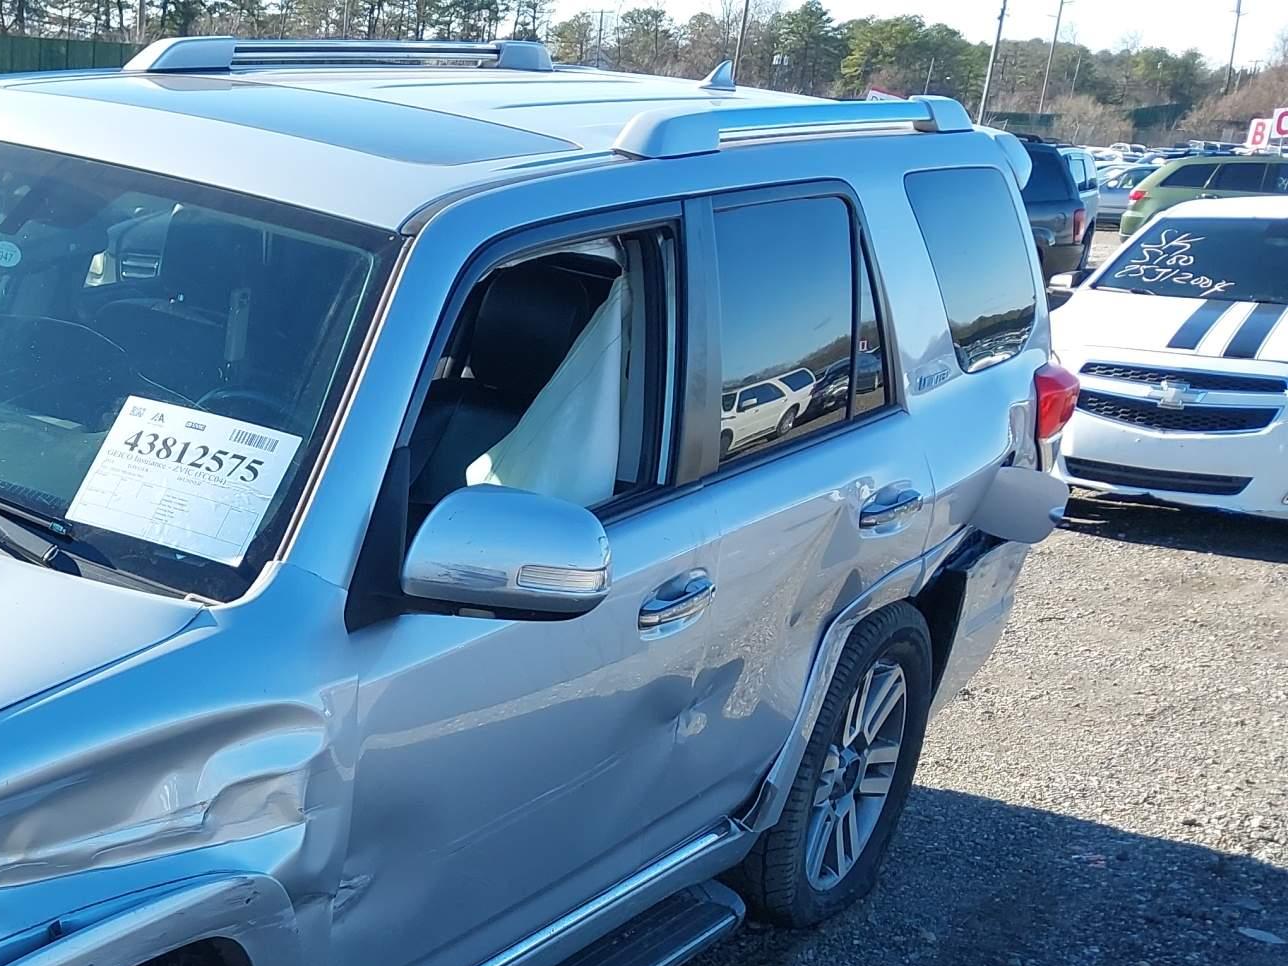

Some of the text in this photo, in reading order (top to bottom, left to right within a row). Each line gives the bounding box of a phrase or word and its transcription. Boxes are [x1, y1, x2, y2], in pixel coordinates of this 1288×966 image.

[1251, 121, 1266, 145] B
[107, 449, 134, 462] GEICO
[124, 430, 265, 483] 43812575
